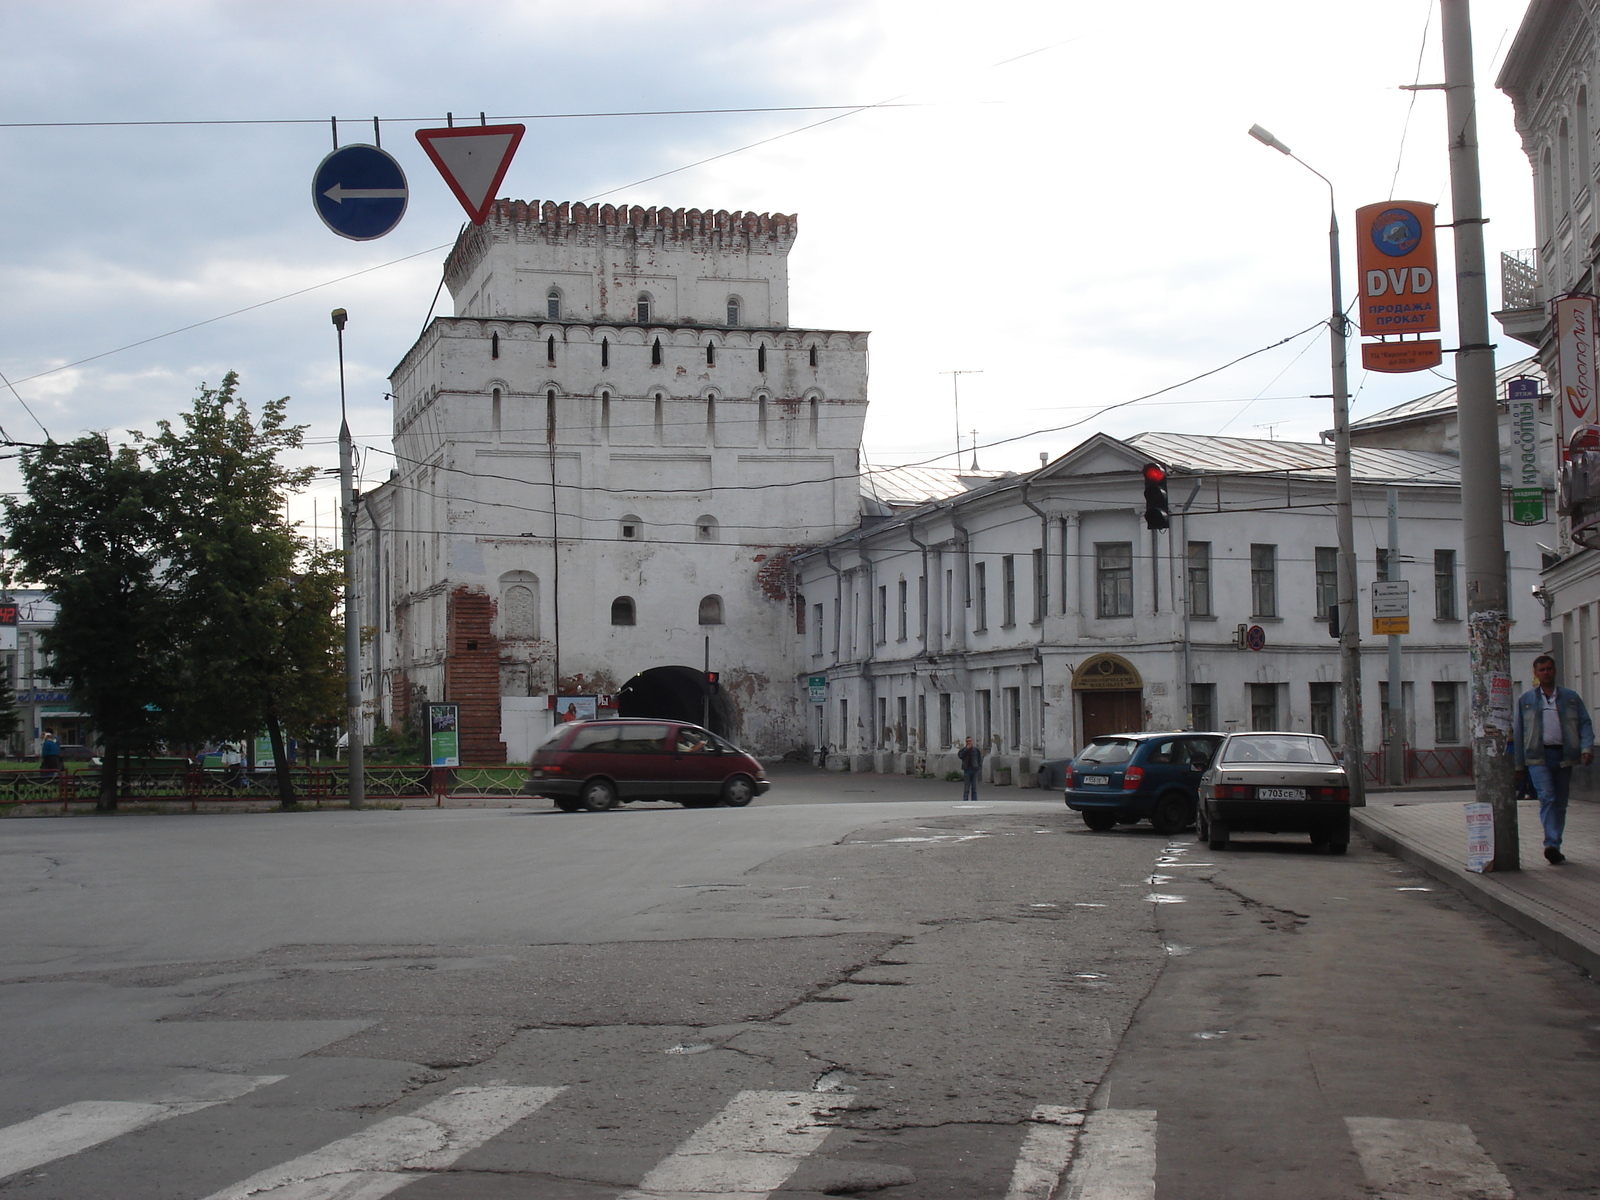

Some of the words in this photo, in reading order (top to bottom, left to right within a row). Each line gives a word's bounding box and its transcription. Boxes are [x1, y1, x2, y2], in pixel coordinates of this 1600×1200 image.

[1367, 266, 1433, 297] DVD
[1369, 303, 1432, 314] ПРОДАЖА
[1376, 314, 1426, 326] ПРОКАТ
[1513, 403, 1521, 445] салон
[1520, 402, 1540, 485] красоты
